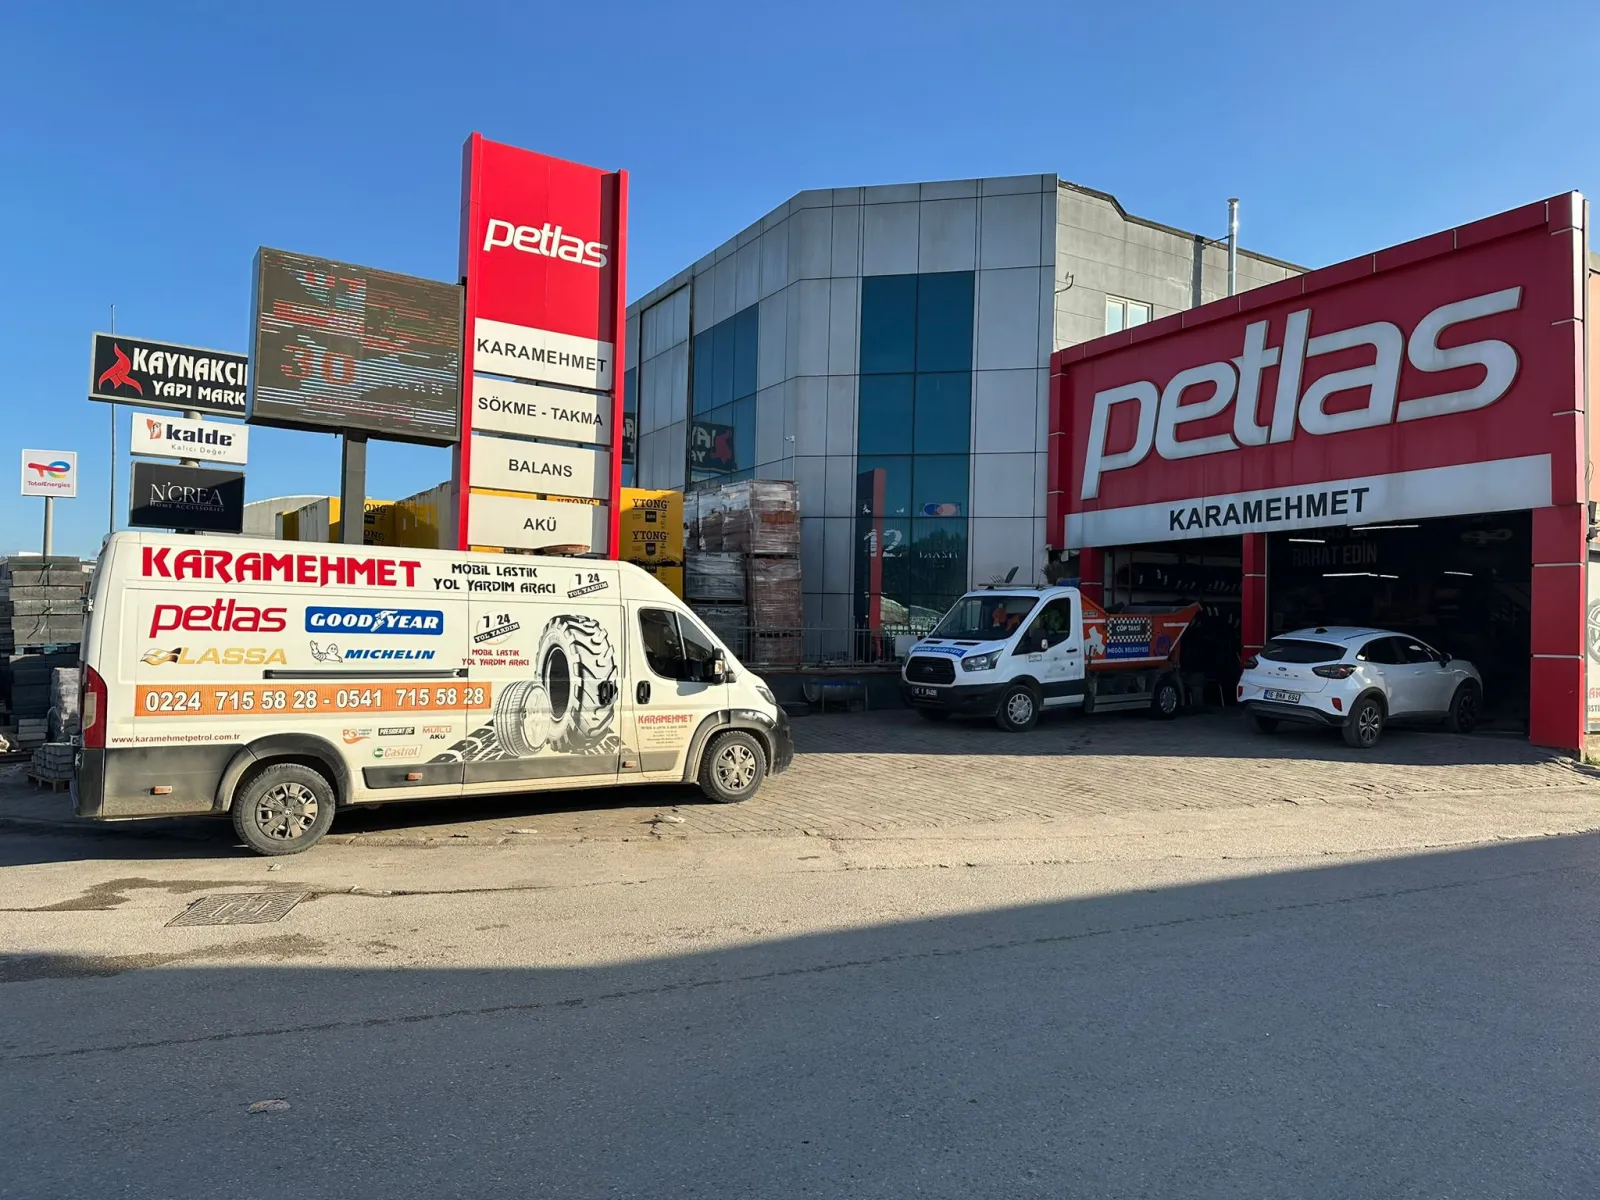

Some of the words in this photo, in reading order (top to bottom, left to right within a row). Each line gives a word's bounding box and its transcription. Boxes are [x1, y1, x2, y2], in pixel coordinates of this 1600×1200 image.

[483, 218, 608, 268] petlas
[477, 338, 607, 373] KARAMEHMET
[153, 380, 191, 398] YAPI
[1080, 285, 1523, 500] petlas
[478, 395, 537, 418] SÖKME
[551, 407, 603, 427] TAKMA
[166, 424, 232, 446] kalde
[508, 458, 573, 478] BALANS
[27, 480, 70, 488] TotalEnergies
[632, 498, 668, 509] YTONG
[1170, 487, 1370, 532] KARAMEHMET
[523, 516, 557, 532] AKÜ
[632, 530, 667, 541] YTONG
[142, 546, 421, 587] KARAMEHMET
[433, 578, 460, 590] YOL
[467, 579, 515, 593] YARDIM
[520, 582, 556, 594] ARACI
[587, 572, 600, 584] 24
[568, 590, 581, 598] YOL
[582, 583, 607, 594] YARDIM
[149, 598, 288, 638] petlas
[483, 615, 490, 628] 7
[496, 613, 511, 626] 24
[475, 635, 490, 644] YOL
[490, 623, 520, 636] YARDIM
[177, 647, 288, 665] LASSA
[344, 649, 436, 660] MICHELIN
[461, 658, 476, 666] YOL
[479, 658, 506, 667] YARDIM
[508, 659, 530, 667] ARACI
[145, 690, 202, 712] 0224
[215, 691, 255, 710] 715
[260, 690, 287, 709] 58
[292, 689, 318, 709] 28
[336, 689, 383, 708] 0541
[395, 688, 430, 707] 715
[435, 687, 457, 706] 58
[462, 687, 484, 705] 28
[637, 714, 694, 724] KARAMEHMET
[111, 732, 241, 743] www.karamehmetpetrol.com.tr
[384, 746, 418, 757] Castrol
